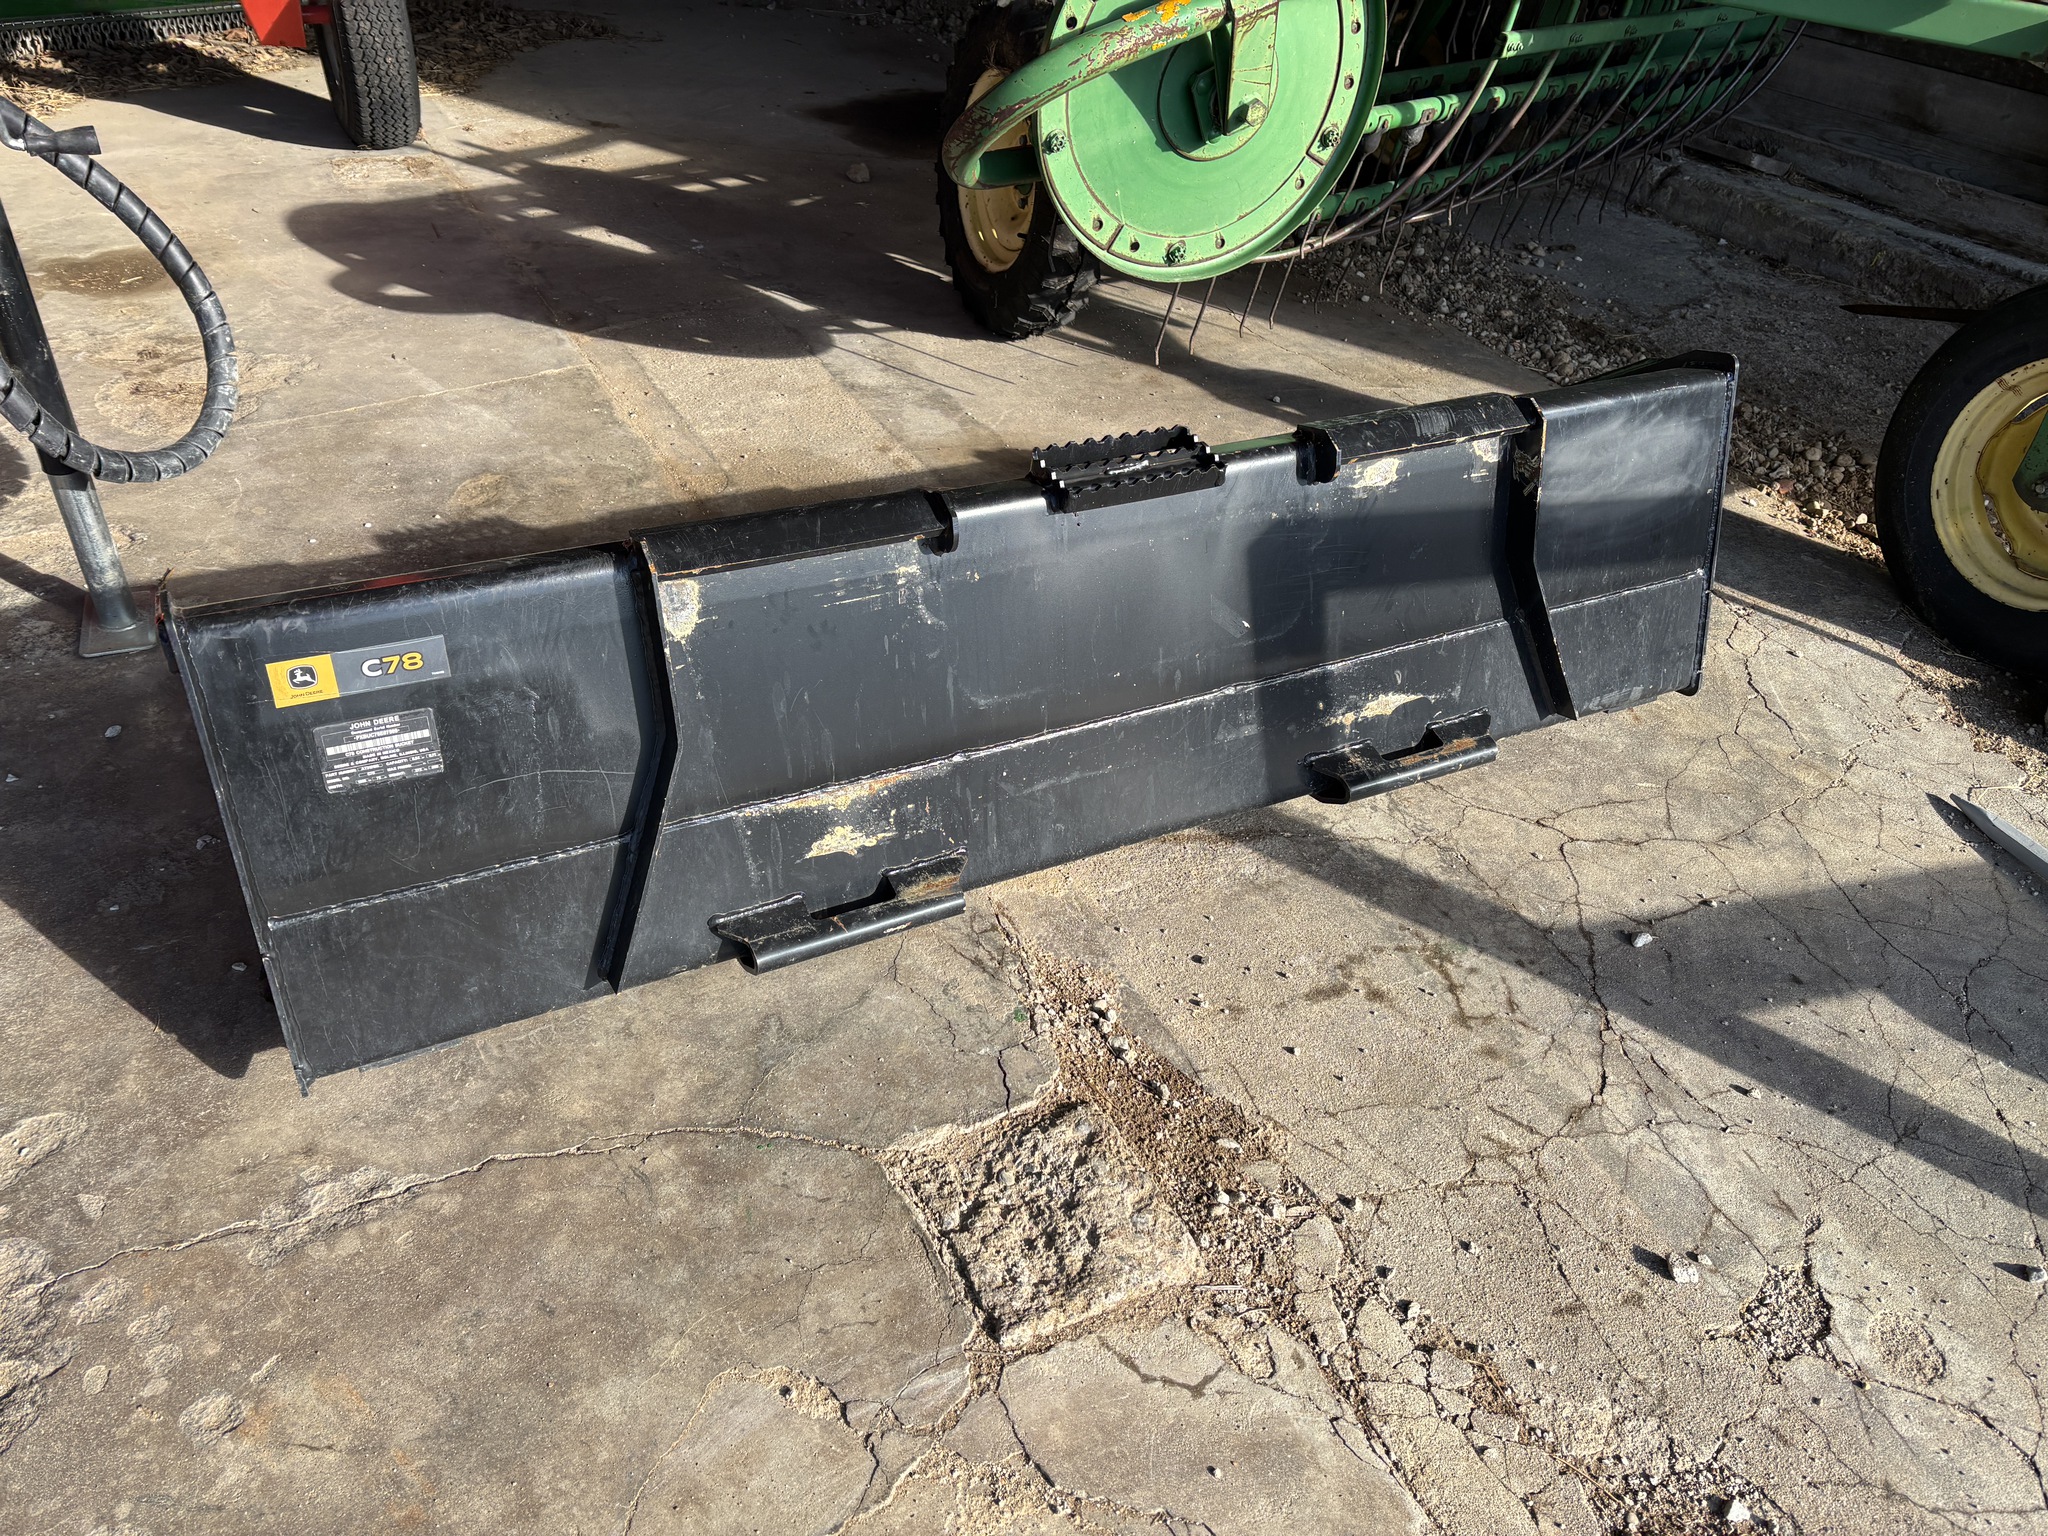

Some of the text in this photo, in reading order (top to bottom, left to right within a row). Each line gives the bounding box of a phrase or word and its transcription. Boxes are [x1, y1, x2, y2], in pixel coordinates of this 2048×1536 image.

[360, 652, 424, 677] C78
[350, 716, 400, 730] JOHN DEERE
[356, 745, 394, 755] CONSTRUCTION
